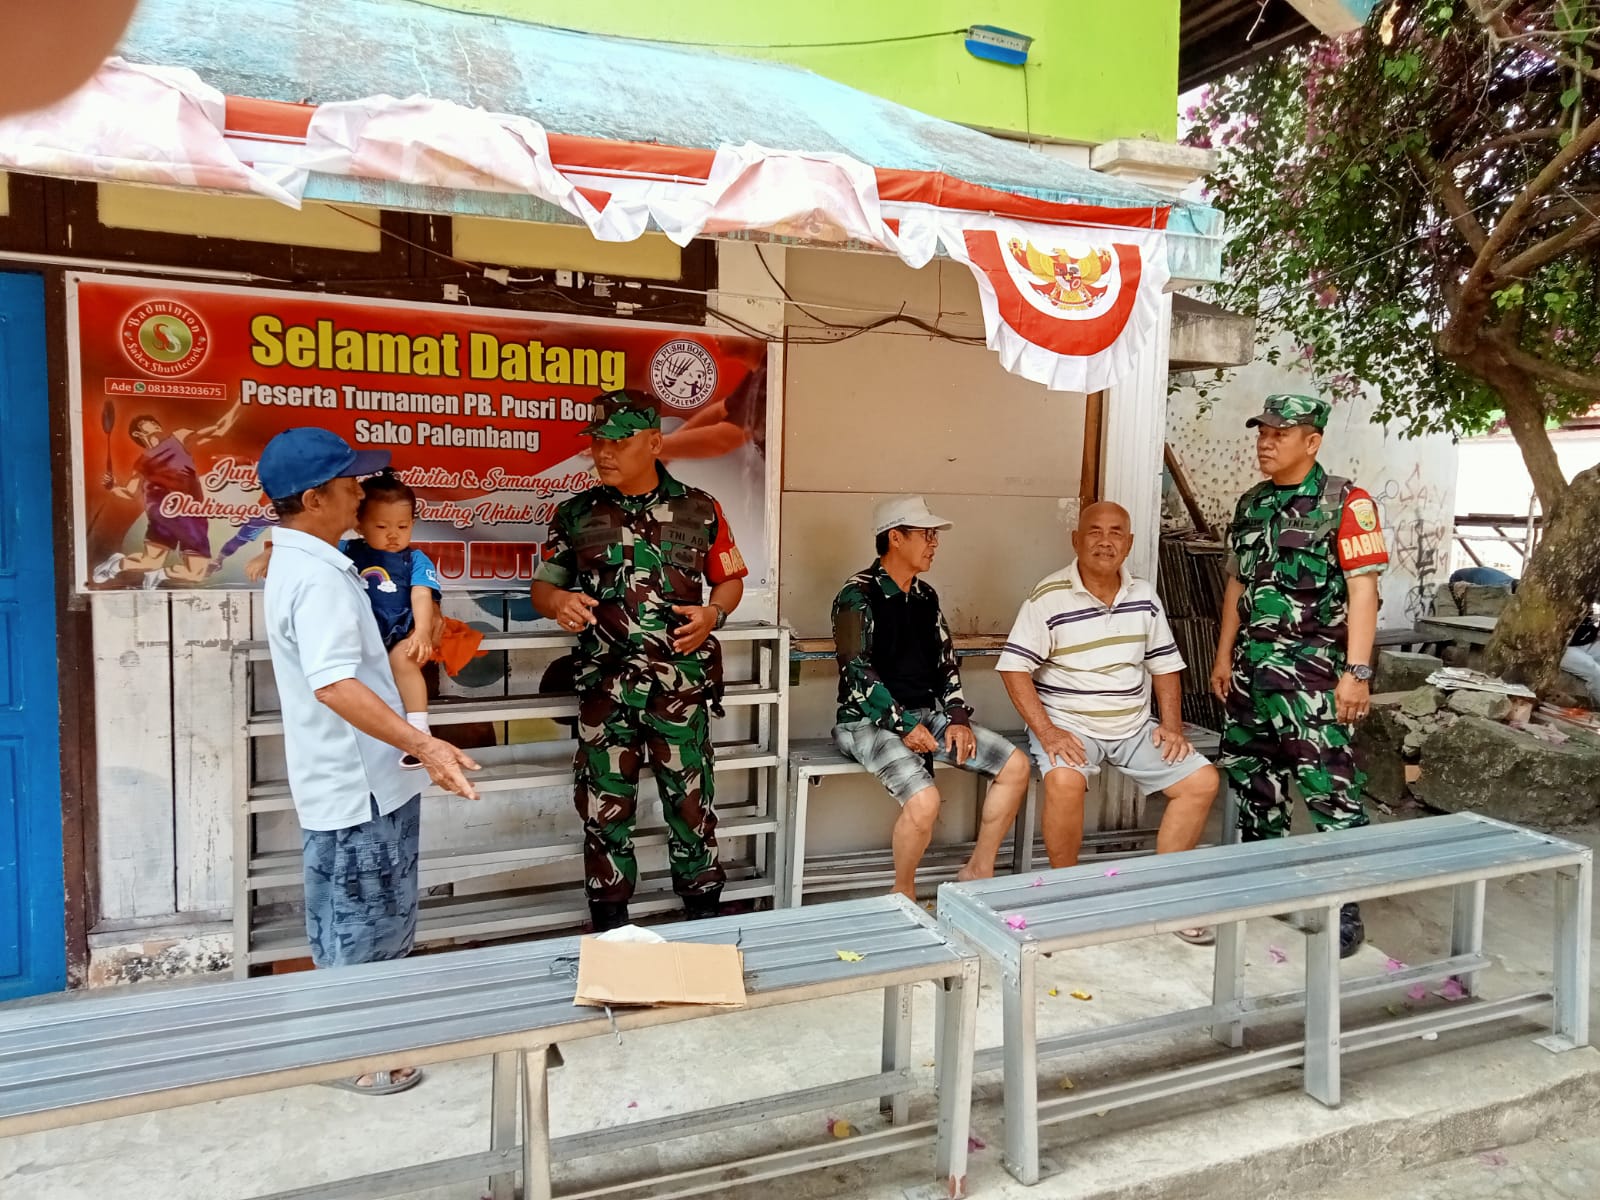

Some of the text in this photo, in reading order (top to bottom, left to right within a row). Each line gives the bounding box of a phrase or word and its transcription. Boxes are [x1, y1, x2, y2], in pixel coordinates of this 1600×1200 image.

[128, 303, 200, 333] Badminton
[151, 347, 205, 373] Shuttlecock
[251, 315, 625, 392] Selamat Datang
[661, 344, 685, 358] PUSRI
[687, 344, 714, 374] BORANG
[111, 382, 222, 396] Ade 081283203675
[241, 379, 337, 408] Peserta
[341, 385, 459, 415] Turnamen
[464, 393, 497, 417] PB.
[501, 395, 556, 420] Pusri
[656, 381, 712, 406] SAKO PALEMBANG
[355, 419, 540, 452] Sako Palembang
[461, 469, 480, 488] &
[481, 467, 569, 498] Semangat
[160, 491, 260, 526] Olahraga
[475, 502, 533, 525] Untuk
[668, 529, 686, 542] TNI
[469, 542, 537, 579] HUT
